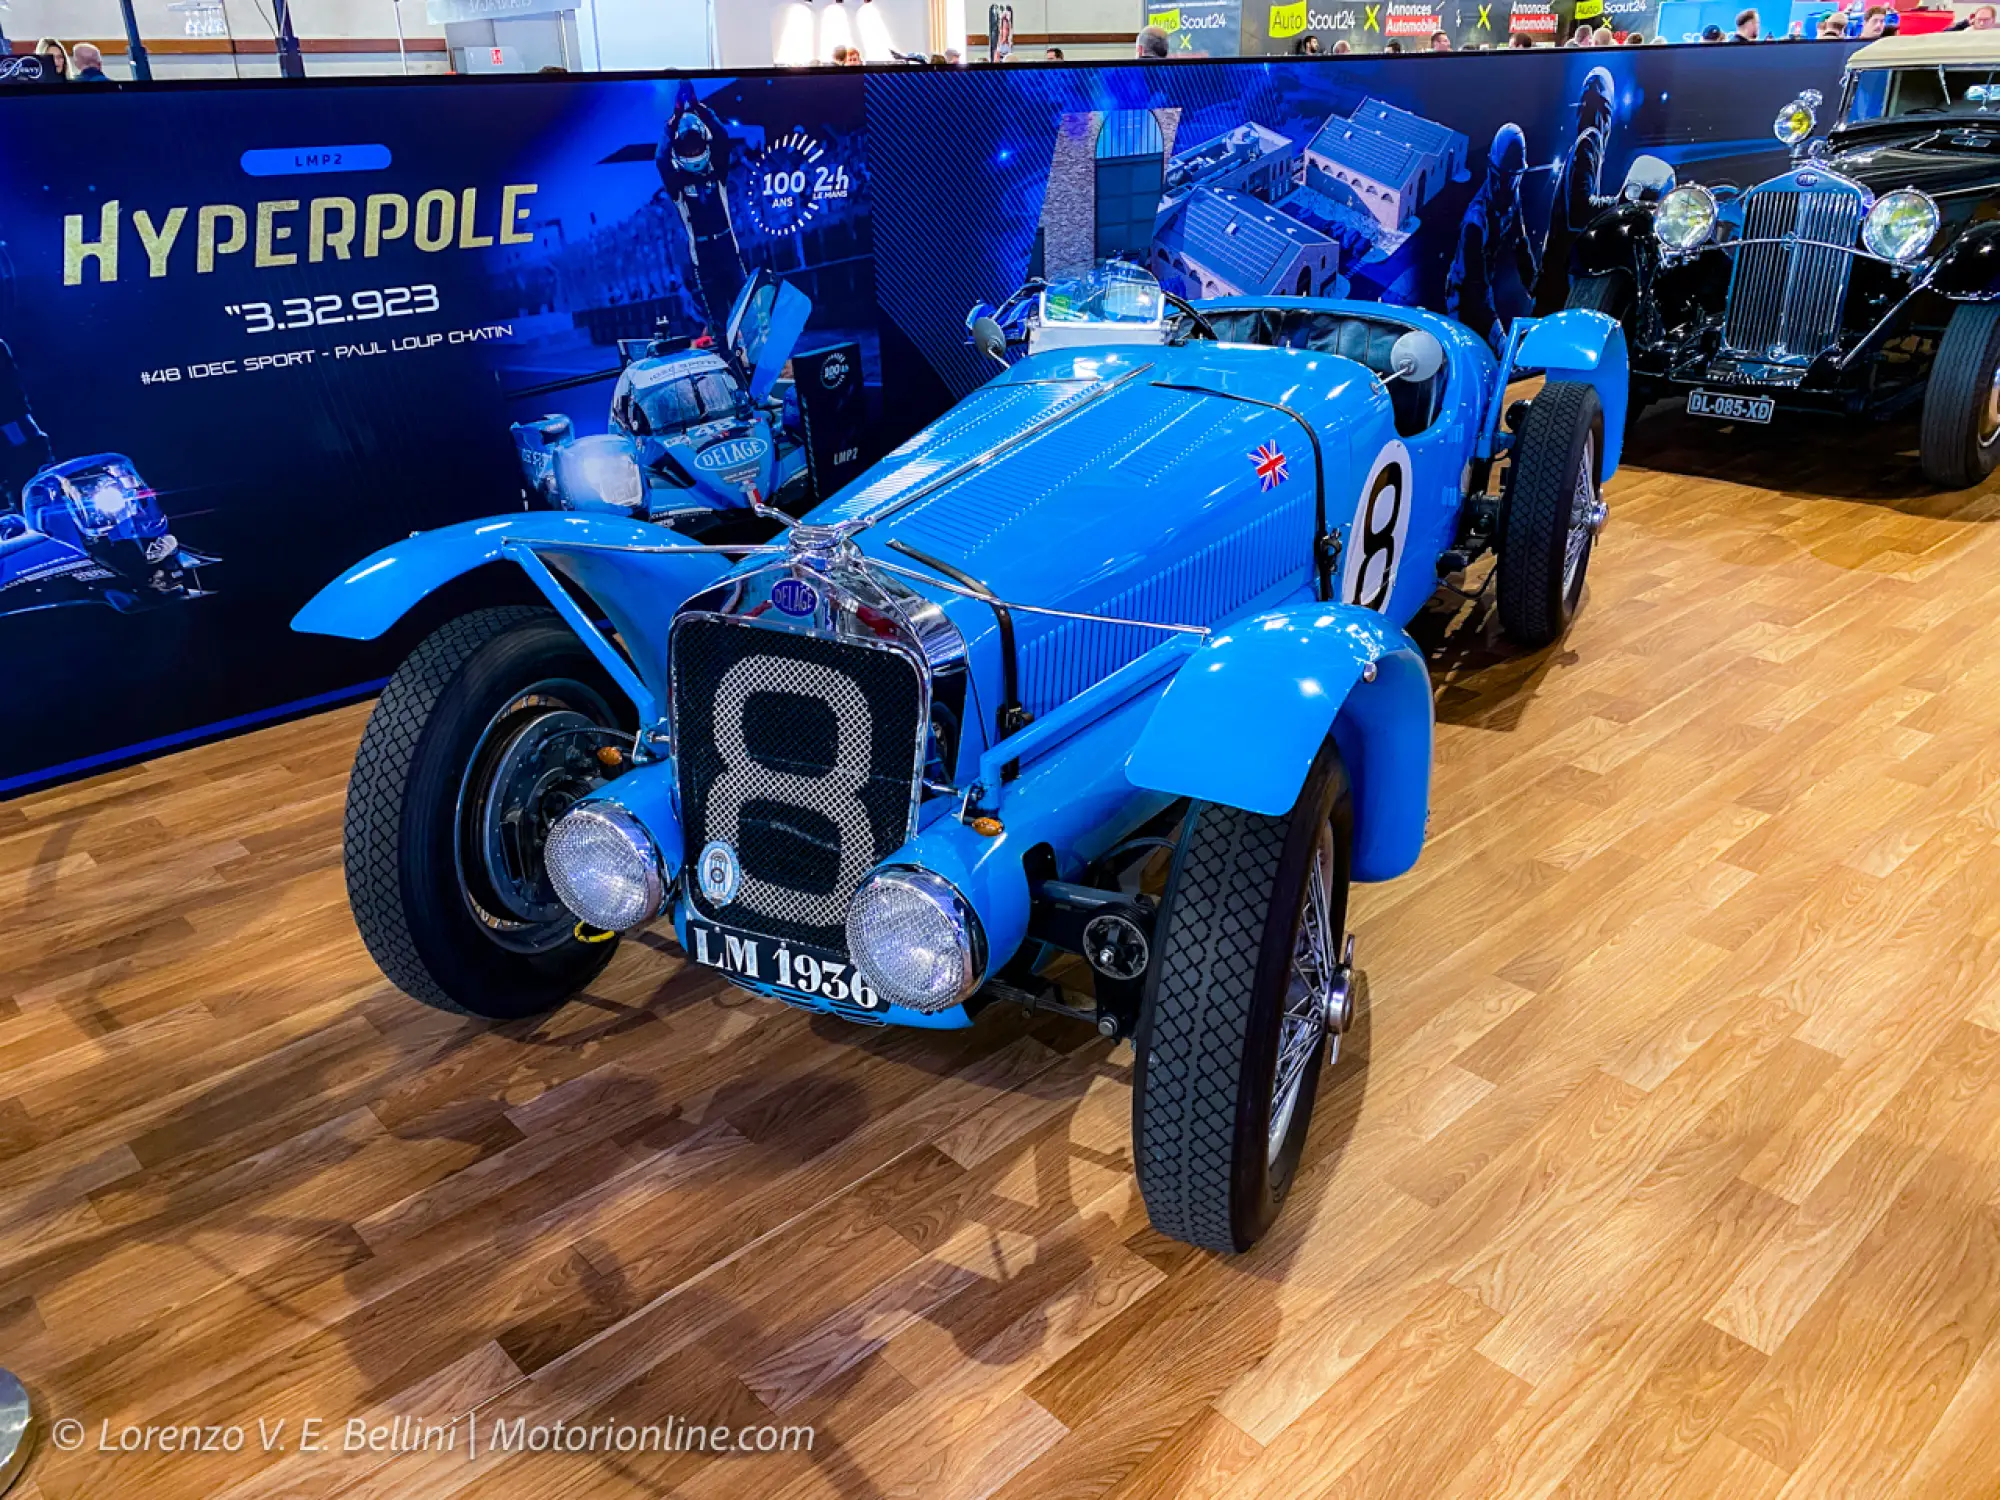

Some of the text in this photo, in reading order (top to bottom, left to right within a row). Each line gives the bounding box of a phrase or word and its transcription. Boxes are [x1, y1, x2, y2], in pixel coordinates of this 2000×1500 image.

[1386, 1, 1432, 16] Annonces
[1510, 1, 1550, 14] Annonces
[1604, 0, 1647, 14] Scout24
[1180, 12, 1227, 29] Scout24
[1272, 11, 1302, 29] Auto
[1308, 9, 1356, 31] Scout24
[294, 152, 343, 168] LMP2
[763, 171, 806, 196] 100
[772, 196, 793, 209] ANS
[63, 183, 538, 287] HYPERPOLE
[140, 367, 181, 386] #48
[188, 359, 239, 380] IDEC
[243, 349, 315, 372] SPORT
[334, 341, 387, 360] PAUL
[391, 333, 443, 352] LOUP
[448, 324, 514, 345] CHATIN
[1690, 393, 1770, 420] DL-085-XD
[701, 440, 762, 467] DELAGE
[833, 446, 859, 466] LMP2
[1351, 461, 1403, 612] 8
[774, 585, 814, 612] DELAGE
[704, 654, 875, 928] 8
[693, 926, 878, 1010] LM 1936
